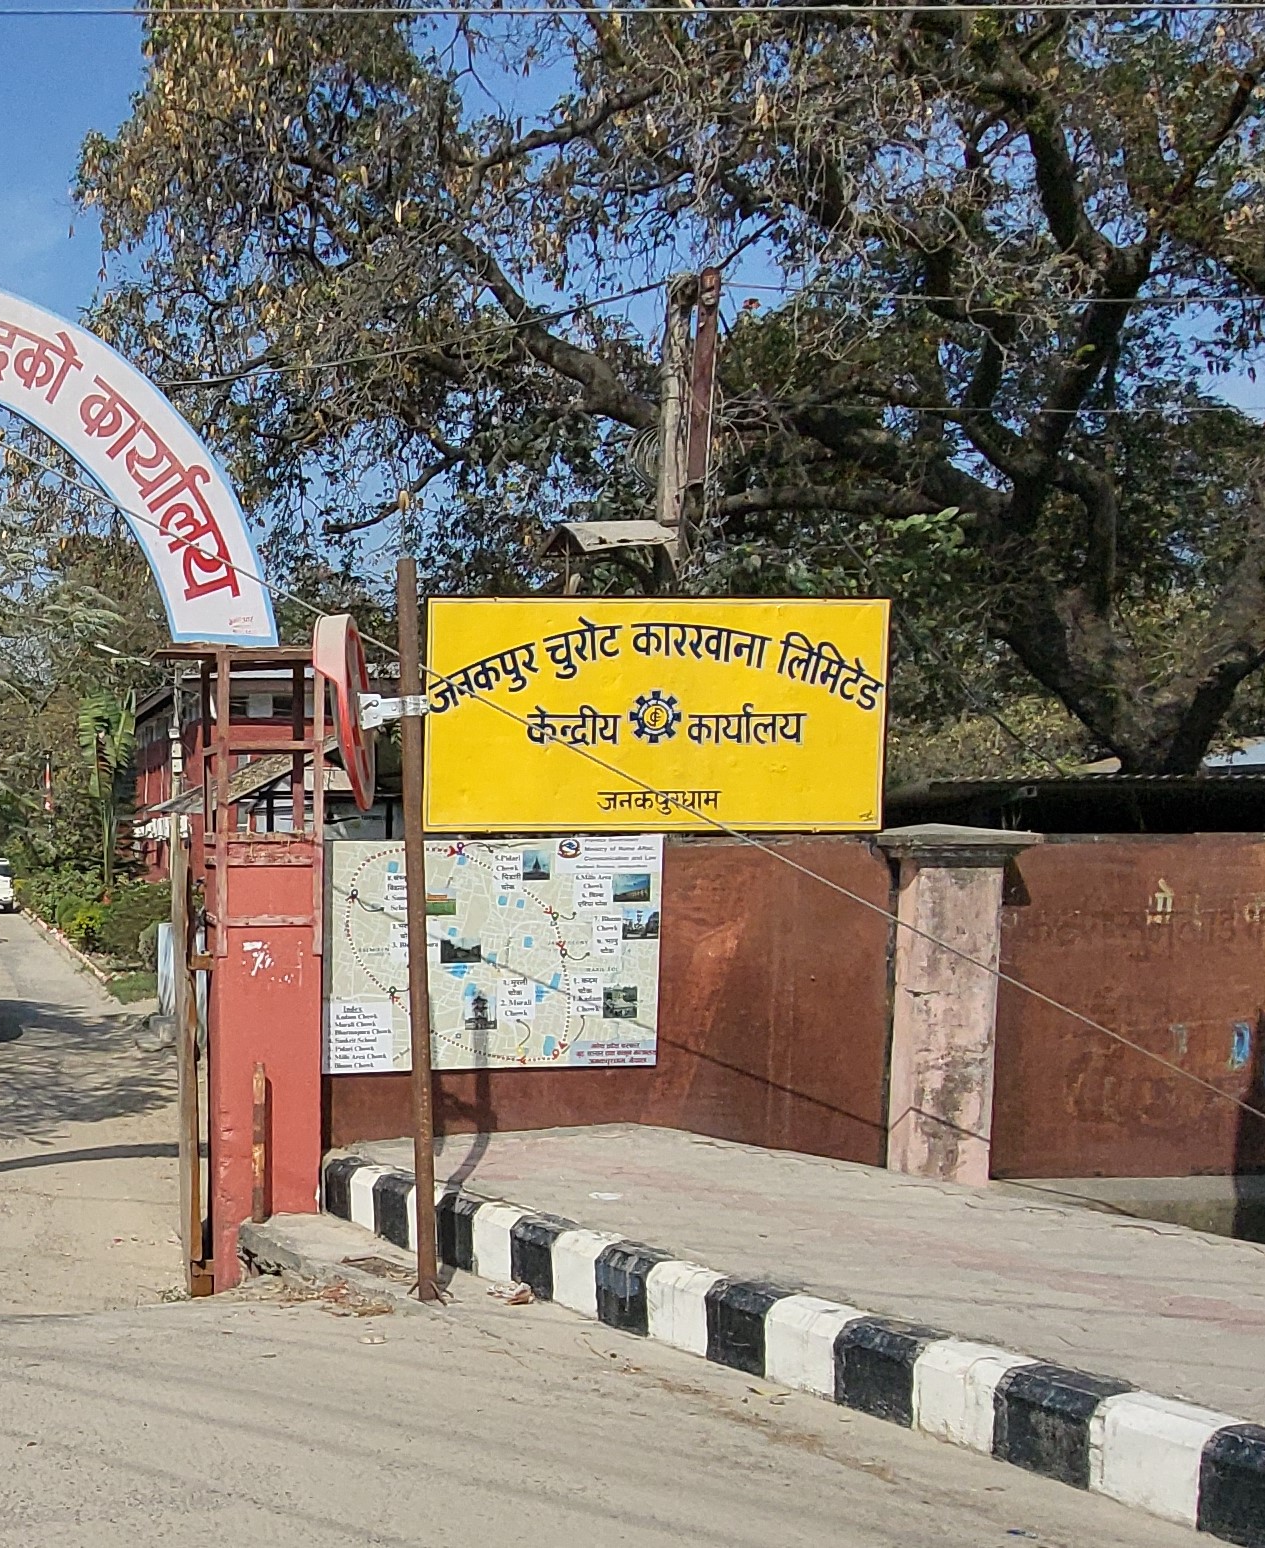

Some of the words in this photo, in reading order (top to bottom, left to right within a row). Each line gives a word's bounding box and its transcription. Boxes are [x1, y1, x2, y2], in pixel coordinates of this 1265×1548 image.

[79, 374, 241, 600] कार्यालय
[428, 641, 540, 713] जनकपुर
[543, 616, 623, 680] चुरोट
[778, 631, 884, 712] लिमिटेड
[527, 705, 623, 746] केन्द्रीय
[688, 703, 807, 744] कार्यालय
[597, 790, 722, 815] जनकपुरधाम
